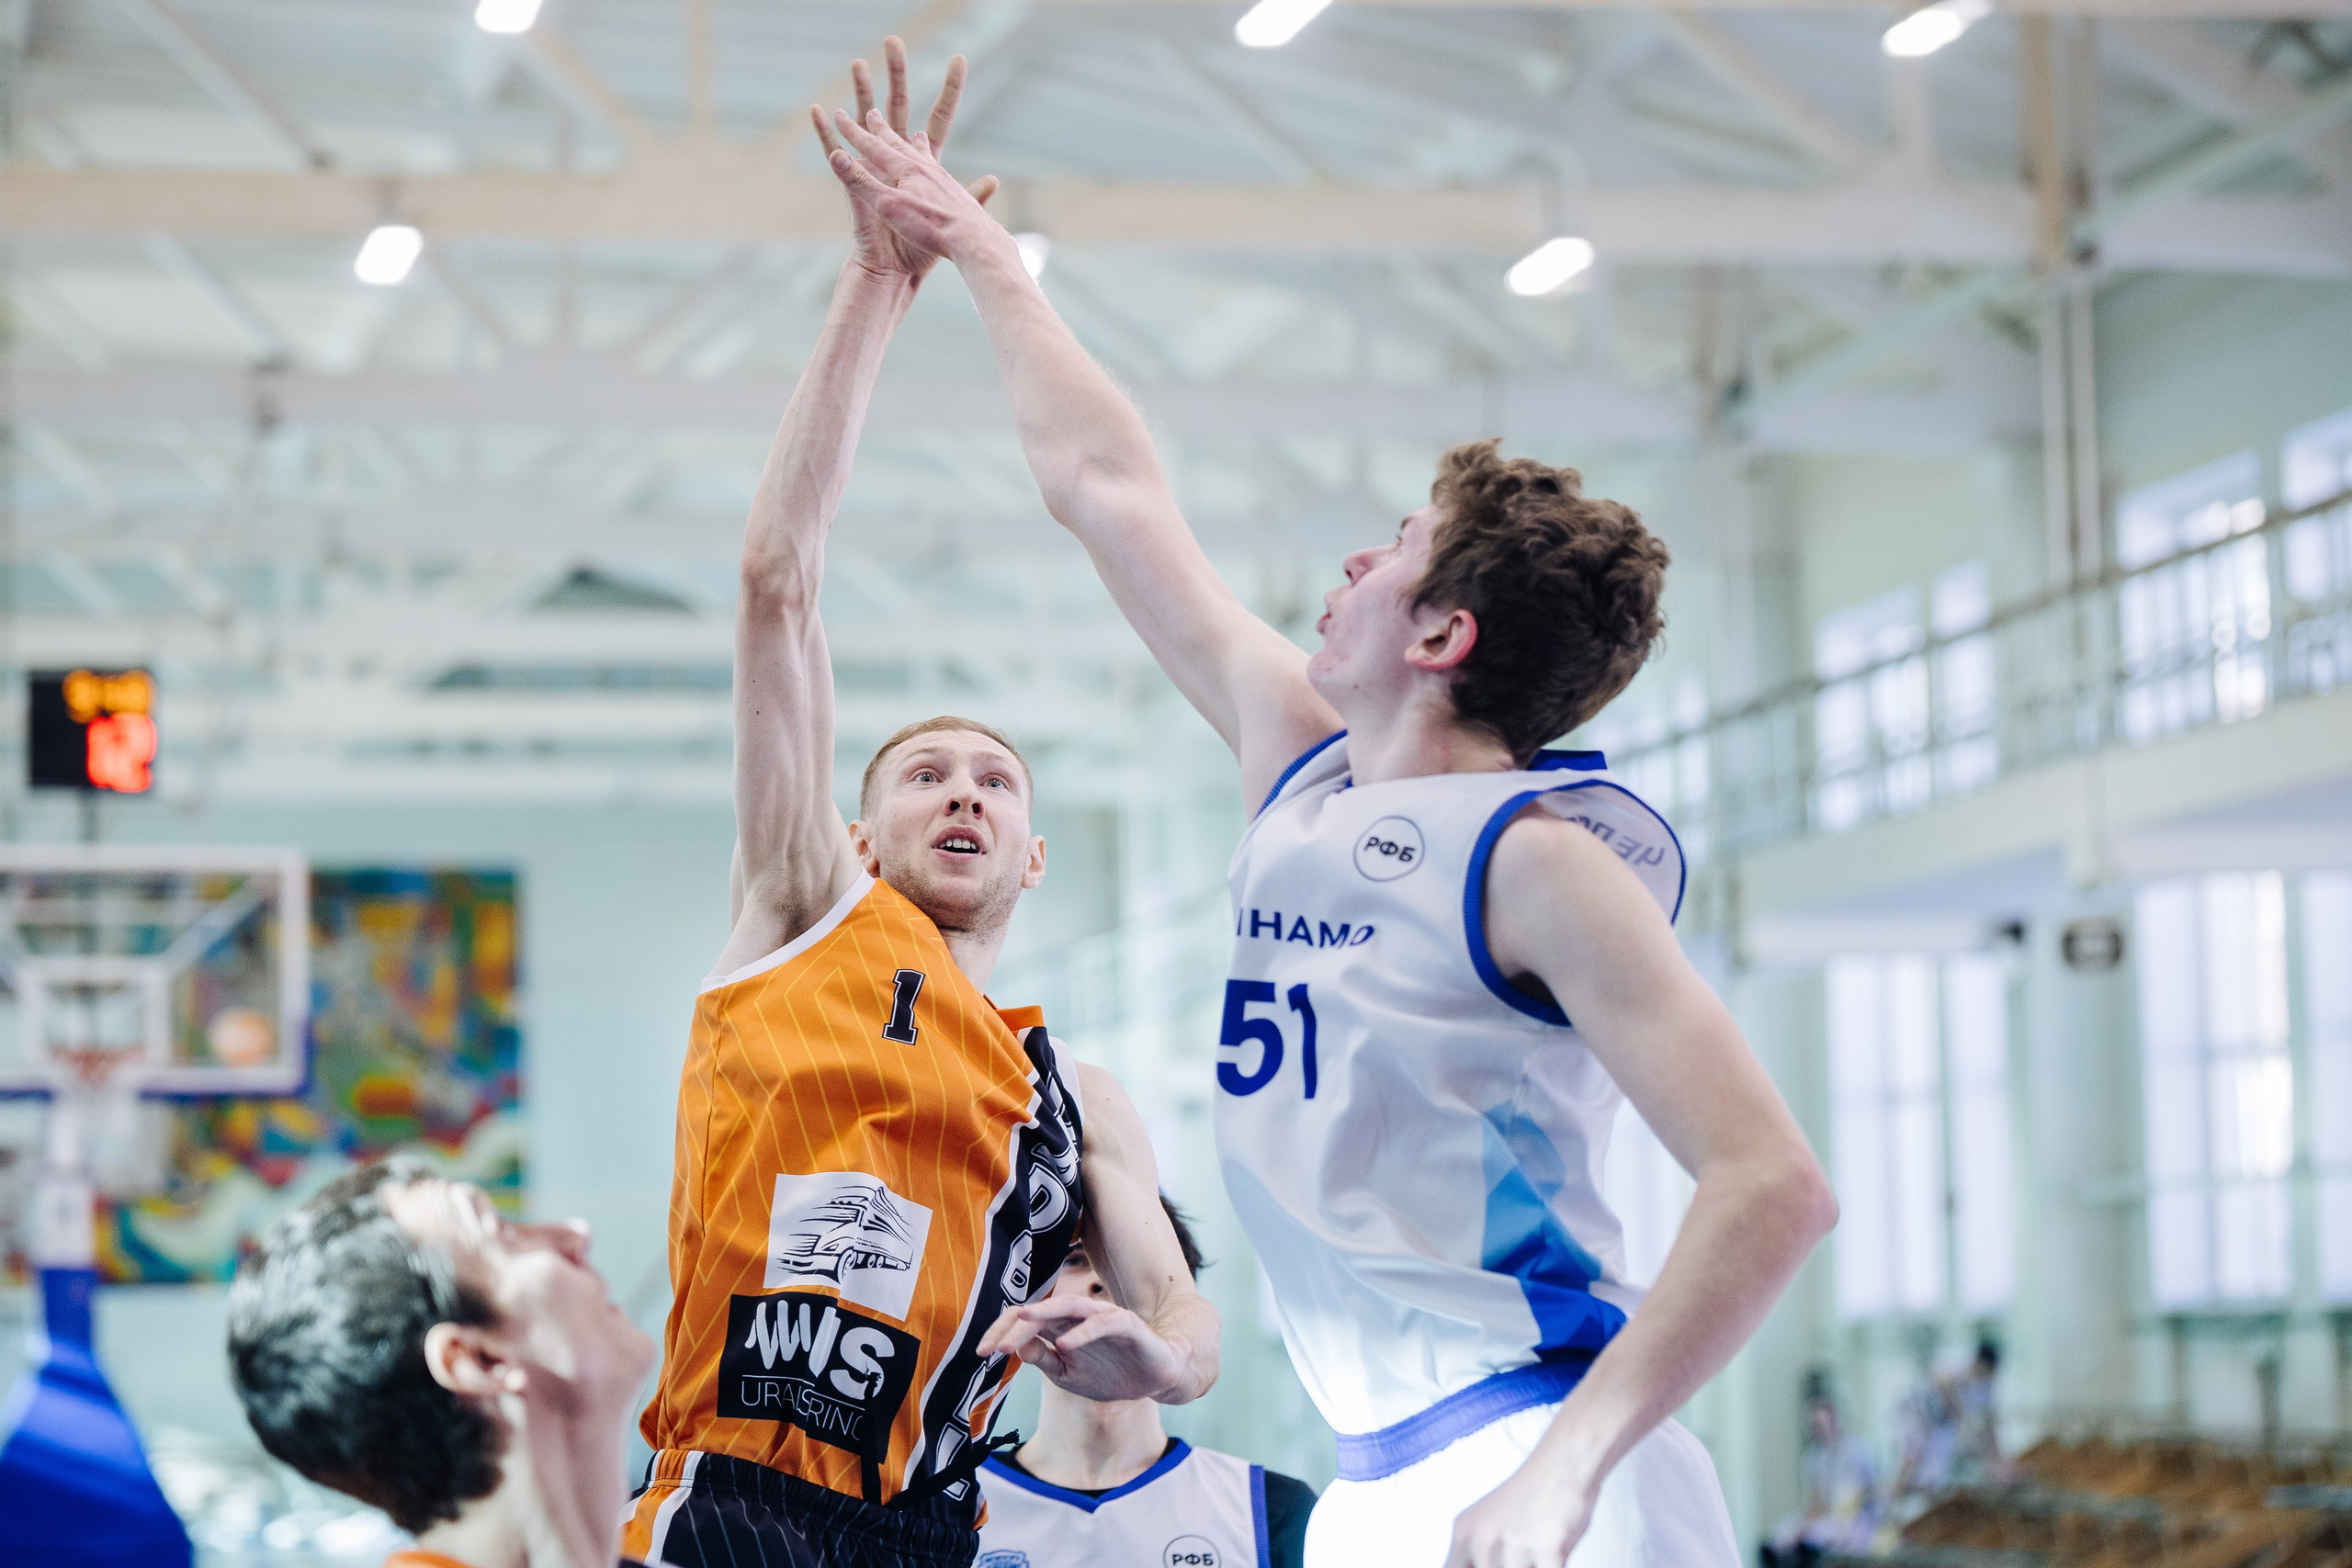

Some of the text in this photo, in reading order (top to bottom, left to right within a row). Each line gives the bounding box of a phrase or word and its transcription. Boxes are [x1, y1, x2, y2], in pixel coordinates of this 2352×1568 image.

[1363, 837, 1416, 862] РФБ
[882, 969, 926, 1045] 1
[1216, 979, 1317, 1099] 51
[1171, 1553, 1214, 1566] РФБ
